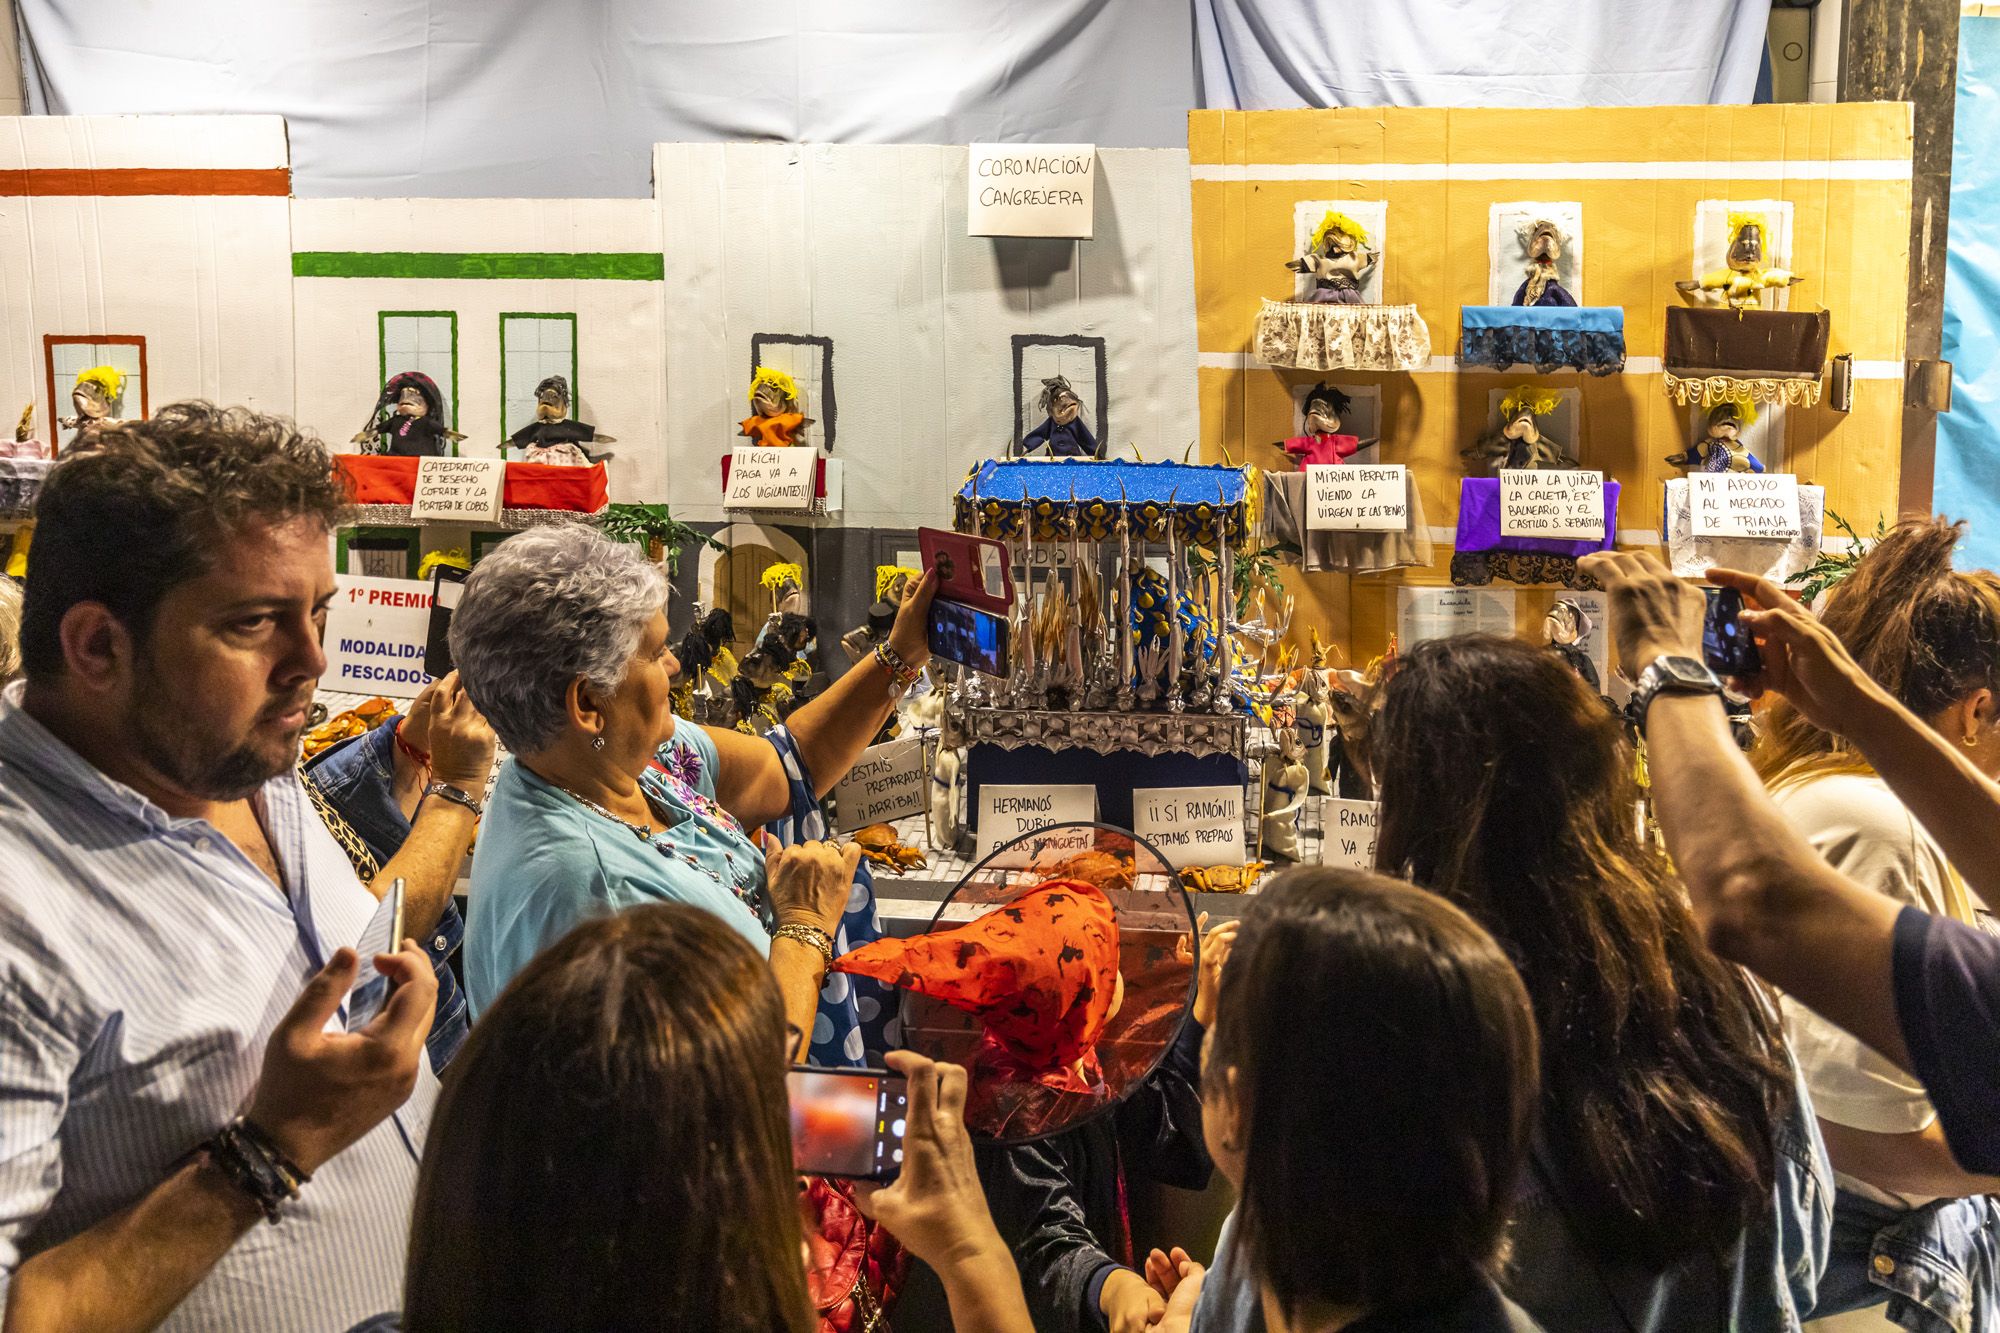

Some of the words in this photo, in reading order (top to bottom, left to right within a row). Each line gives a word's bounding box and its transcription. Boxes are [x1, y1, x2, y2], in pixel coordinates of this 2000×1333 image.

[978, 155, 1091, 177] CORONACIÓN
[980, 186, 1083, 206] CANGREJERA
[422, 461, 490, 472] CATEDRATICA
[735, 469, 761, 480] PAGA
[769, 467, 781, 478] YA
[789, 467, 798, 477] A
[422, 475, 433, 484] DE
[439, 475, 479, 484] DESECHO
[1315, 469, 1355, 483] MIRIAN
[1359, 469, 1399, 482] PERALTA
[1546, 474, 1561, 485] LA
[1567, 472, 1601, 489] VIÑA,
[421, 487, 460, 496] COFRADE
[465, 487, 472, 496] Y
[474, 487, 487, 497] LA
[1700, 478, 1715, 492] MI
[1728, 478, 1778, 491] APOYO
[732, 486, 752, 499] LOS
[1317, 487, 1352, 502] VIENDO
[1361, 488, 1376, 499] LA
[1509, 490, 1522, 501] LA
[1528, 490, 1570, 502] CALETA,
[419, 500, 452, 511] PORTERA
[454, 501, 463, 511] DE
[465, 501, 489, 512] COBOS
[1508, 503, 1560, 516] BALNEARIO
[1566, 505, 1573, 514] Y
[1577, 504, 1591, 514] EL
[1703, 498, 1719, 510] AL
[1729, 497, 1785, 510] MERCADO
[1317, 505, 1353, 519] VIRGEN
[1357, 506, 1366, 517] DE
[1368, 505, 1381, 517] LAS
[1508, 516, 1548, 529] CASTILLO
[1552, 518, 1561, 529] S.
[1704, 515, 1720, 528] DE
[1733, 515, 1787, 528] TRIANA
[1759, 529, 1768, 537] ME
[368, 589, 441, 609] PREMIO
[340, 638, 426, 659] MODALIDA
[342, 664, 433, 684] PESCADOS
[865, 765, 932, 796] PREPARADO?
[993, 795, 1052, 814] HERMANOS
[1146, 830, 1190, 848] ESTAMOS
[1195, 829, 1234, 844] PREPAOS
[1341, 838, 1357, 855] YA
